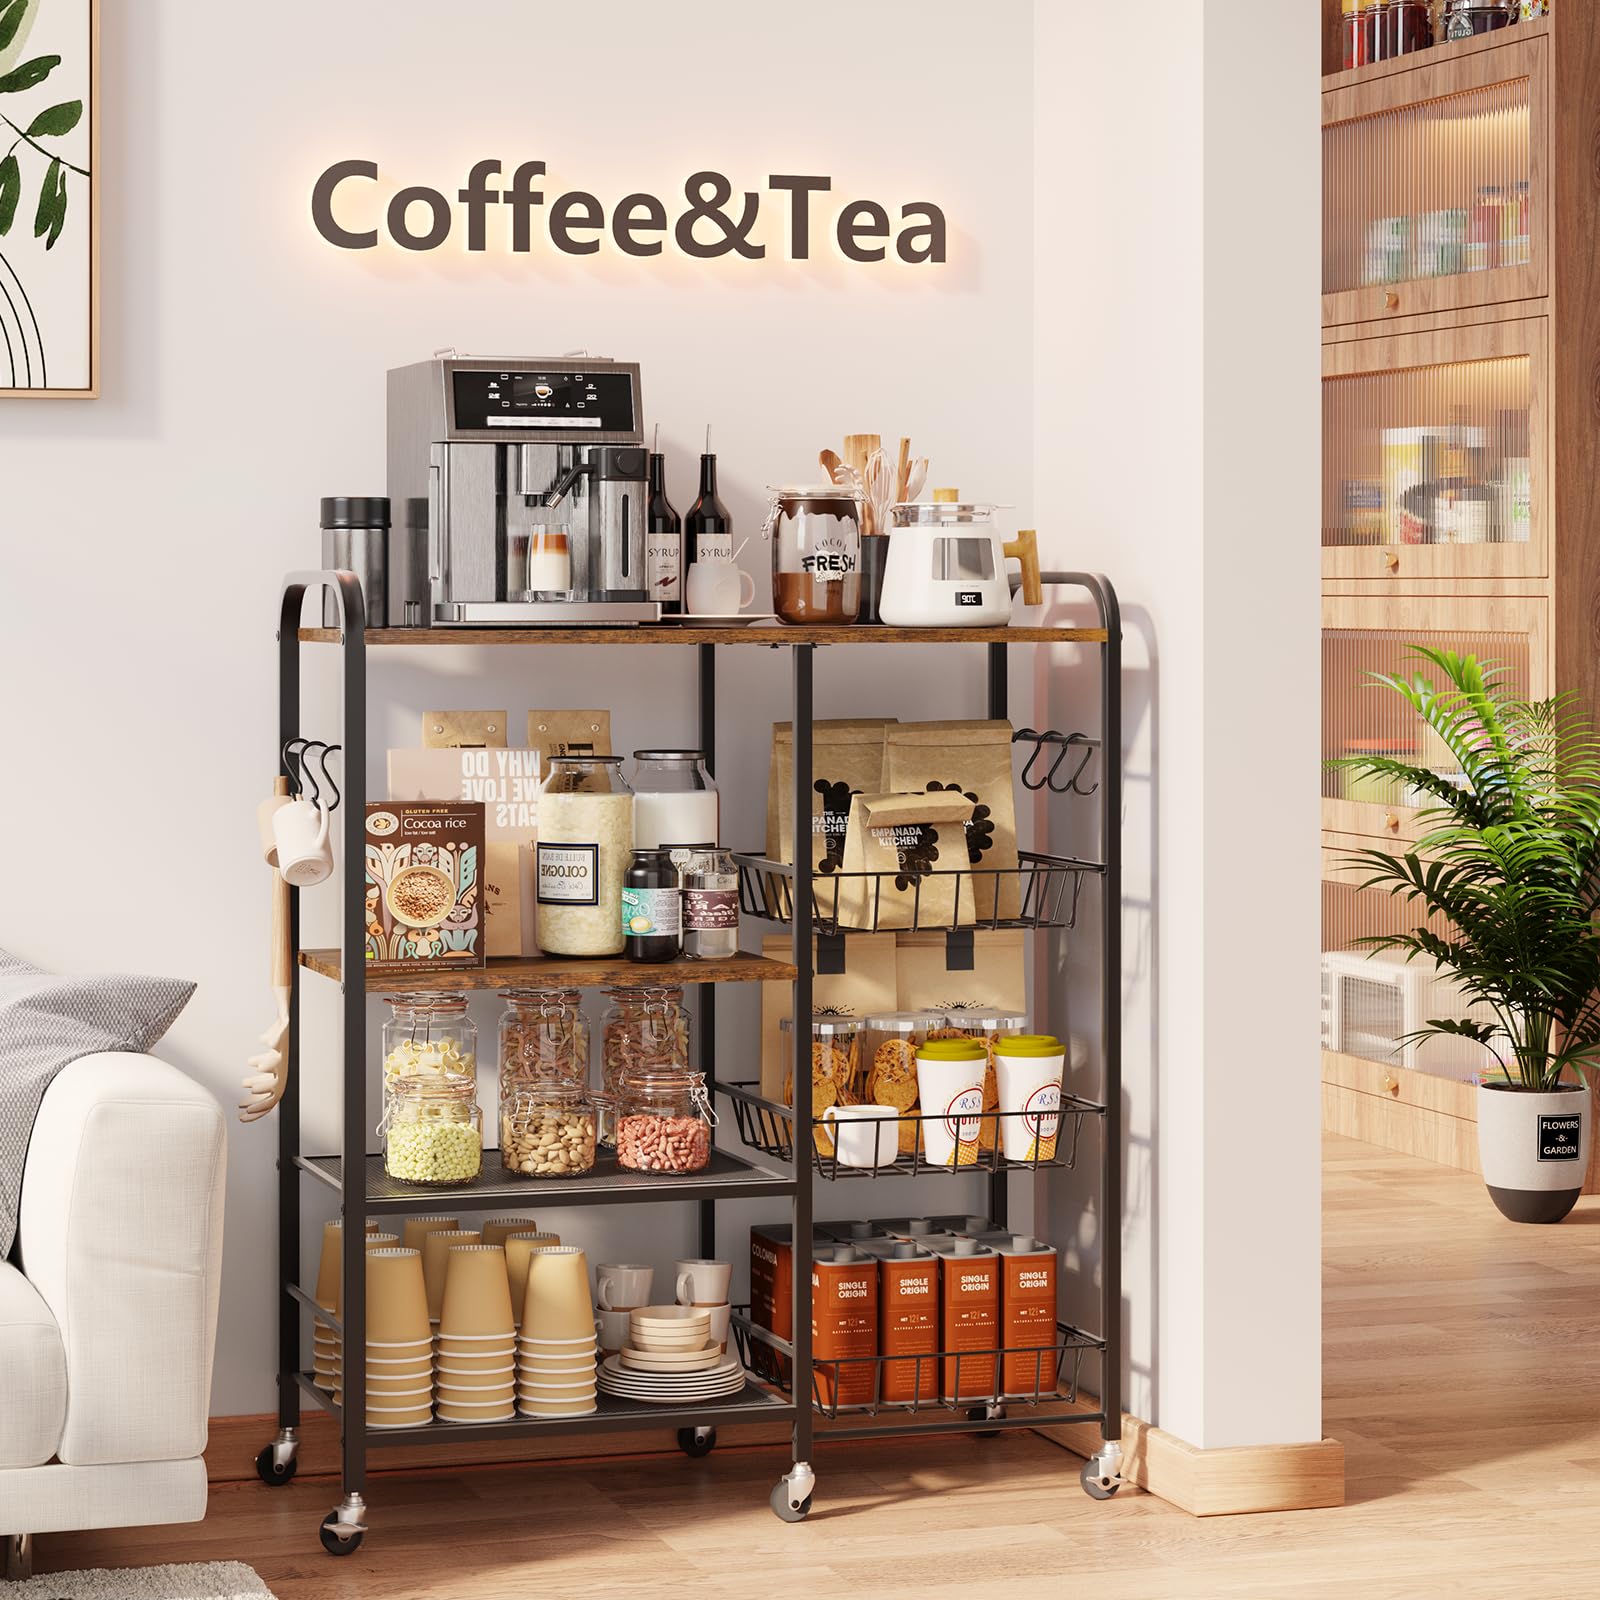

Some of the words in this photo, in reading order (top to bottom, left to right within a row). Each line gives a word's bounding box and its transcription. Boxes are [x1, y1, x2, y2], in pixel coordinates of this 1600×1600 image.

[311, 159, 947, 263] Coffee&Tea
[802, 554, 856, 572] FRESH
[404, 817, 442, 829] Cocoa
[445, 817, 467, 829] rice
[871, 827, 922, 837] EMPANADA
[879, 836, 918, 846] KITCHEN
[1542, 1121, 1579, 1130] FLOWERS
[1543, 1146, 1577, 1154] GARDEN
[961, 1275, 989, 1283] SINGLE
[1019, 1272, 1047, 1280] SINGLE
[838, 1281, 867, 1290] SINGLE
[900, 1278, 928, 1286] SINGLE
[1019, 1279, 1047, 1288] ORIGIN
[900, 1286, 928, 1295] ORIGIN
[961, 1283, 989, 1291] ORIGIN
[838, 1290, 867, 1298] ORIGIN
